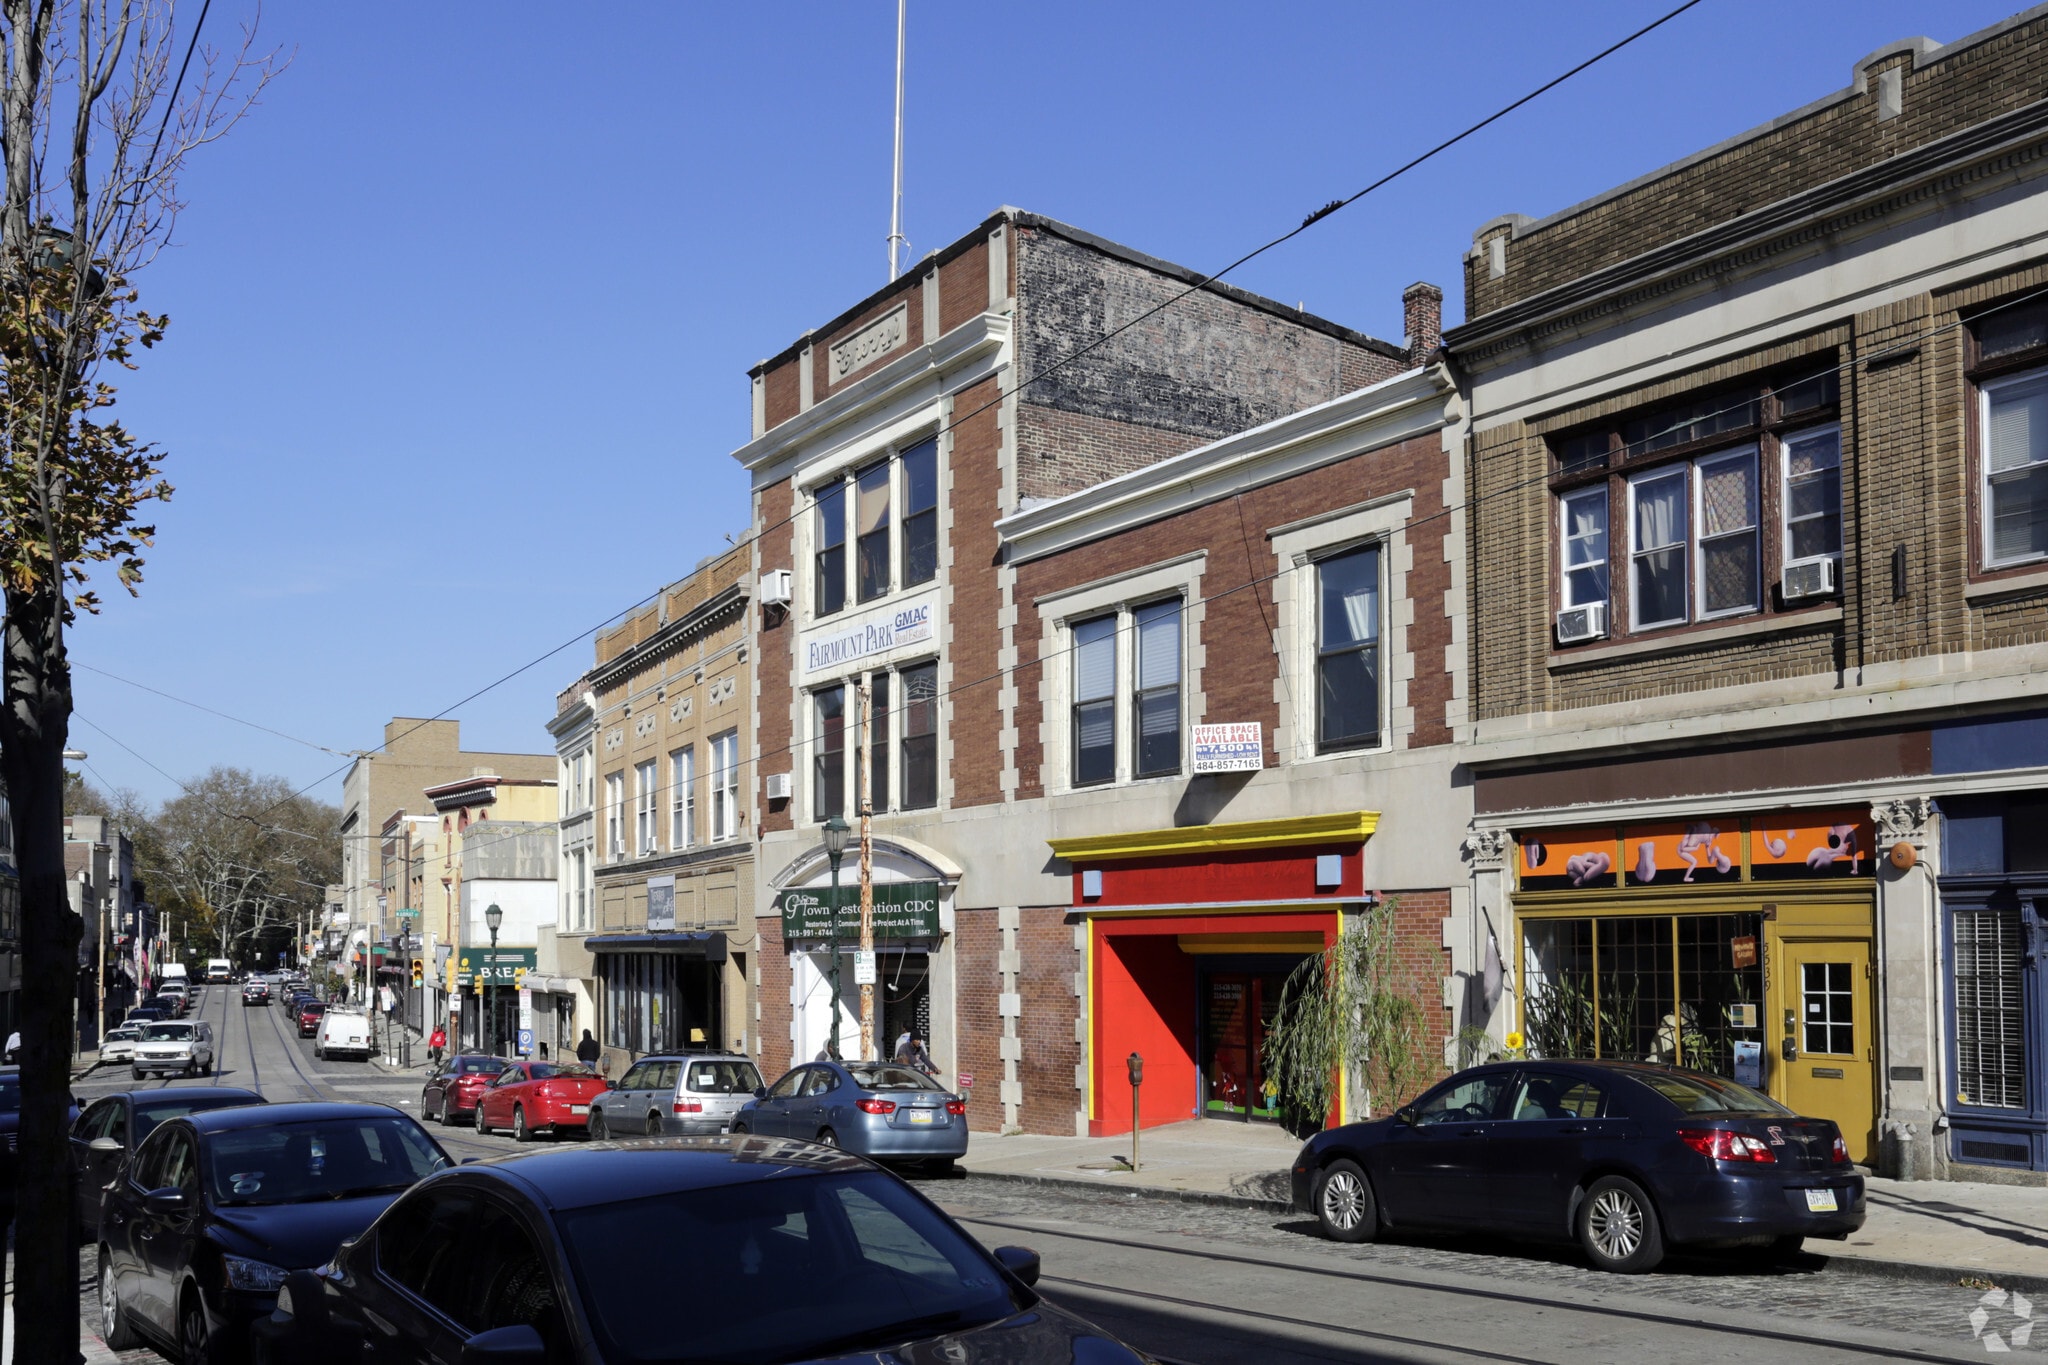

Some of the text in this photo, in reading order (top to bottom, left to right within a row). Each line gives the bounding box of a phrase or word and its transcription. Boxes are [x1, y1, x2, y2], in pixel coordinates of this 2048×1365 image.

[895, 605, 928, 628] GMAC
[895, 627, 928, 646] Real Estate
[809, 624, 893, 669] FAIRMOUNT PARK
[1195, 724, 1258, 736] OFFICE SPACE
[1195, 733, 1260, 744] AVAILABLE
[1208, 744, 1244, 754] 7,500
[1196, 759, 1260, 771] 484-857-7165
[838, 901, 901, 914] estoation
[904, 900, 934, 912] CDC
[910, 918, 924, 926] Time
[788, 929, 833, 937] 215-991-4744
